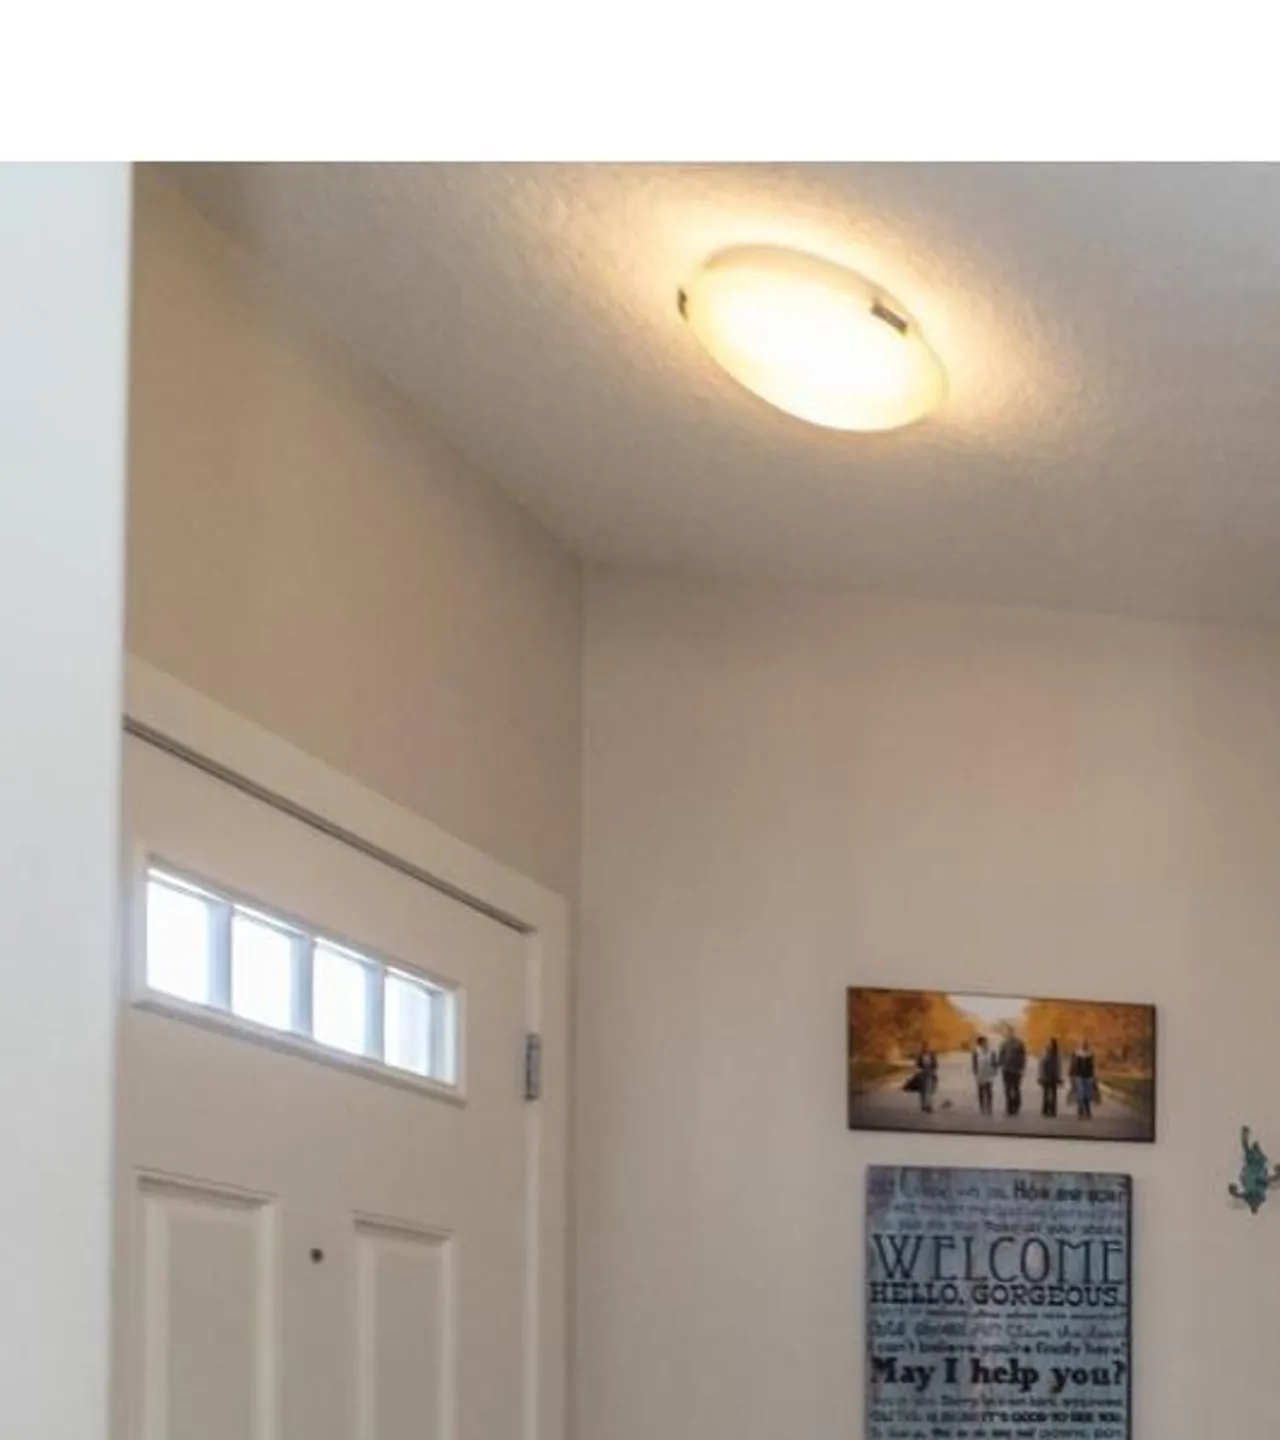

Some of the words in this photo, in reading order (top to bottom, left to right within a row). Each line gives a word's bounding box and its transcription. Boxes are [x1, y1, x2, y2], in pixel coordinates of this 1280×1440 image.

[871, 1233, 1125, 1286] WELCOME
[871, 1356, 934, 1392] May
[943, 1357, 960, 1384] I
[970, 1357, 1039, 1393] help
[1049, 1360, 1127, 1393] you?
